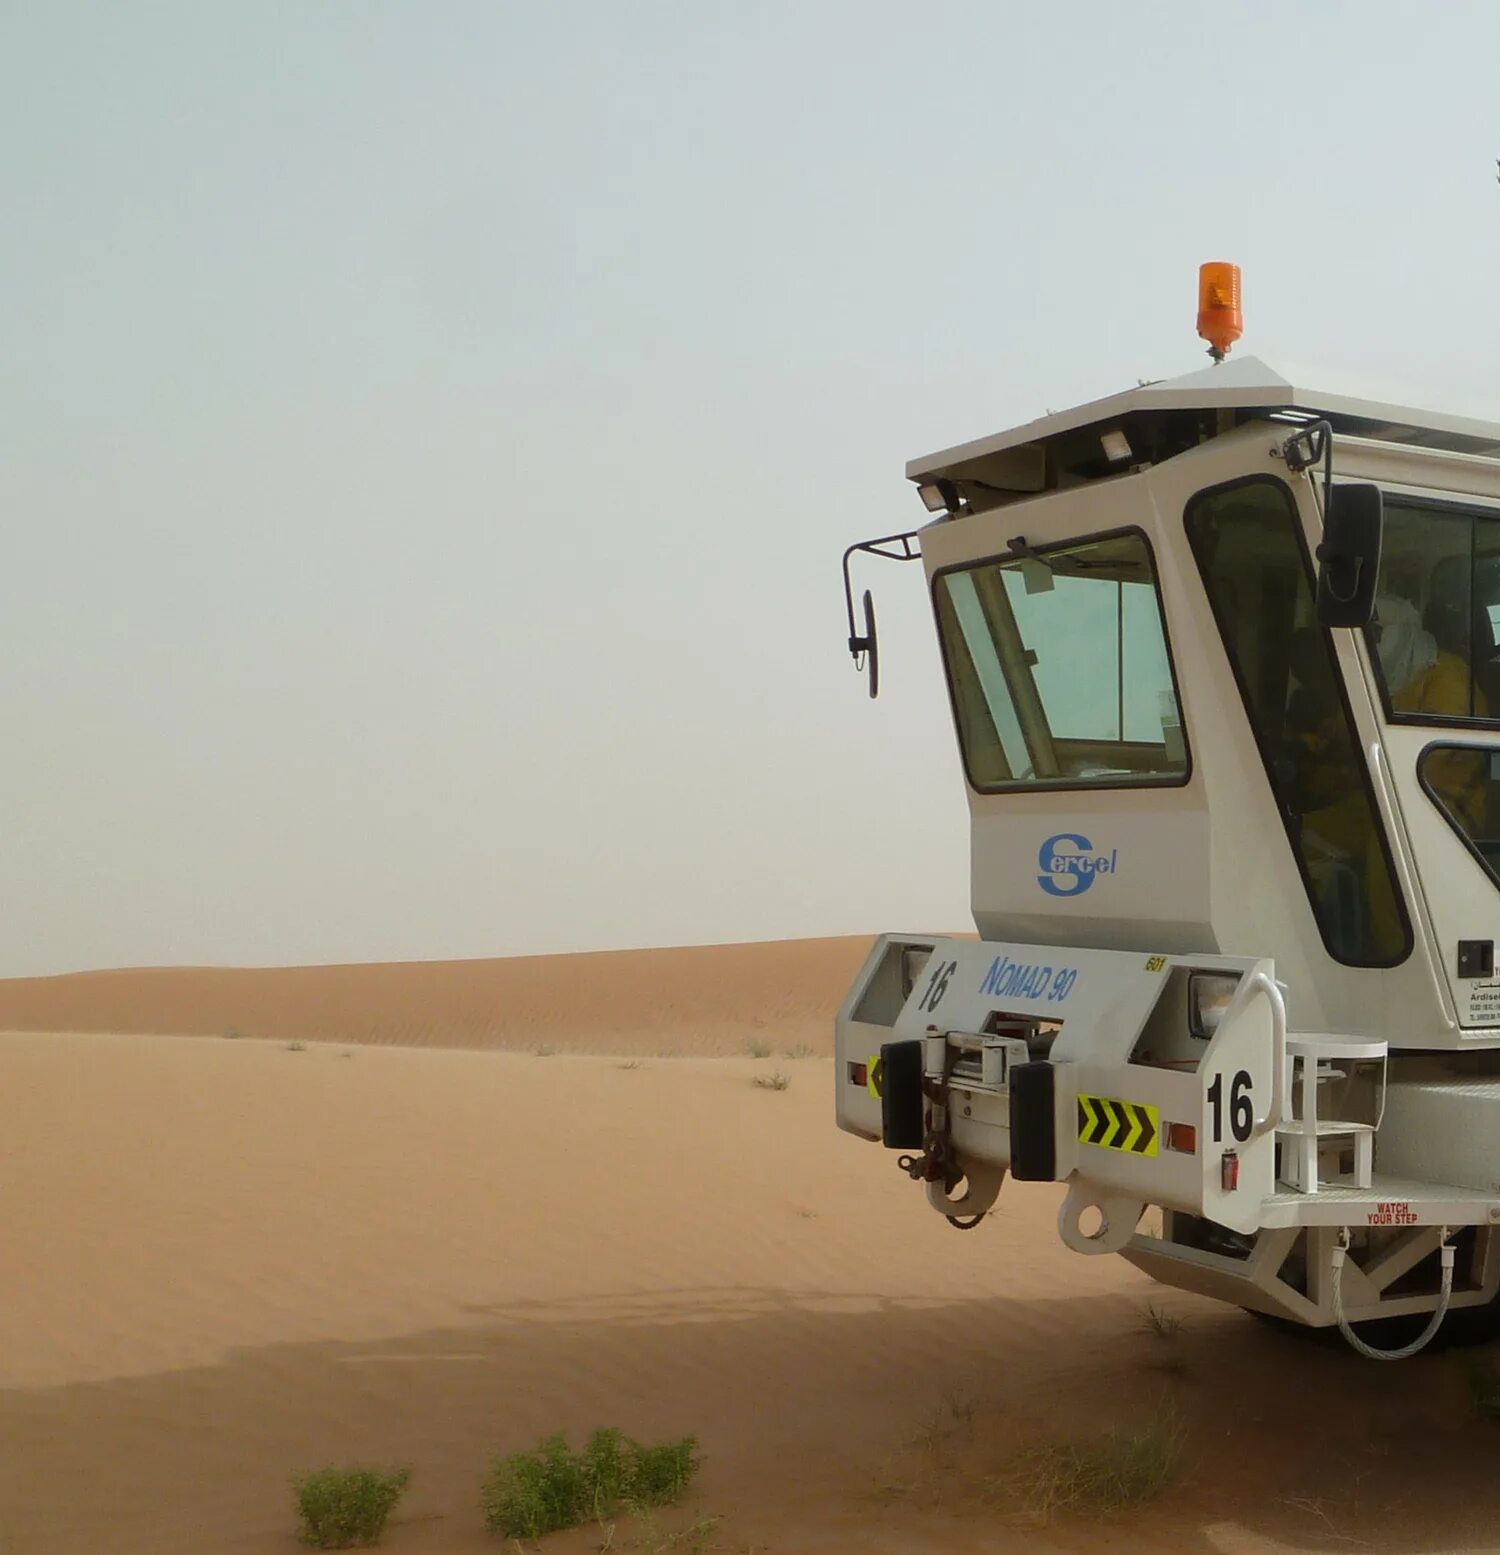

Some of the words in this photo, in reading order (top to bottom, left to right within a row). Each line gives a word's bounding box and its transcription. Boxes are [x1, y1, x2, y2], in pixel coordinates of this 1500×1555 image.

[1037, 833, 1117, 897] Sercel
[1146, 957, 1166, 971] 601
[918, 961, 958, 1013] 16
[1049, 968, 1077, 1002] 90
[1207, 1070, 1253, 1142] 16
[1367, 1213, 1392, 1224] YOUR
[1395, 1213, 1418, 1224] STEP
[1377, 1202, 1409, 1213] WATCH
